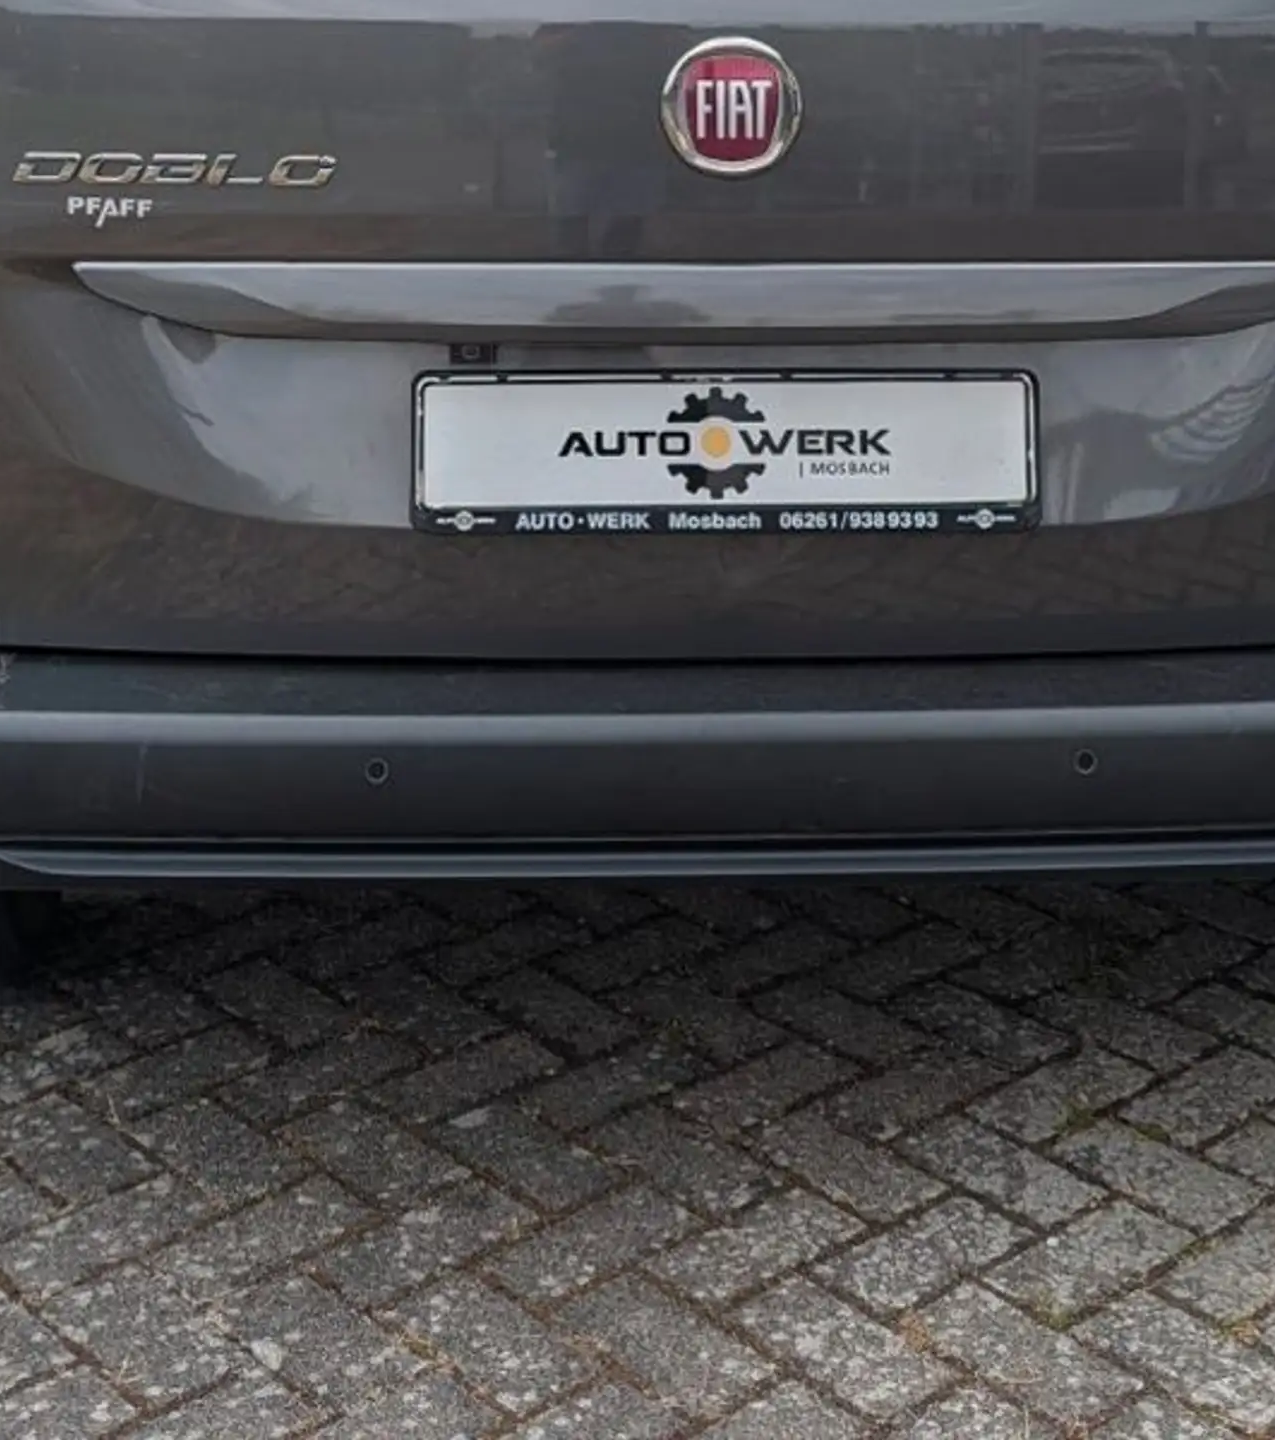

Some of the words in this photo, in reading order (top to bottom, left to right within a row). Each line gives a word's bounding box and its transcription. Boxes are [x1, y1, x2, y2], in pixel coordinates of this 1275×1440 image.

[696, 79, 773, 139] FIAT
[12, 150, 337, 187] DOBLO
[66, 196, 153, 228] PFAFF
[558, 430, 691, 457] AUTO
[738, 429, 892, 456] WERK
[810, 462, 890, 475] MOSBACH
[668, 511, 762, 530] Mosbach
[779, 511, 940, 530] 06261/9389393
